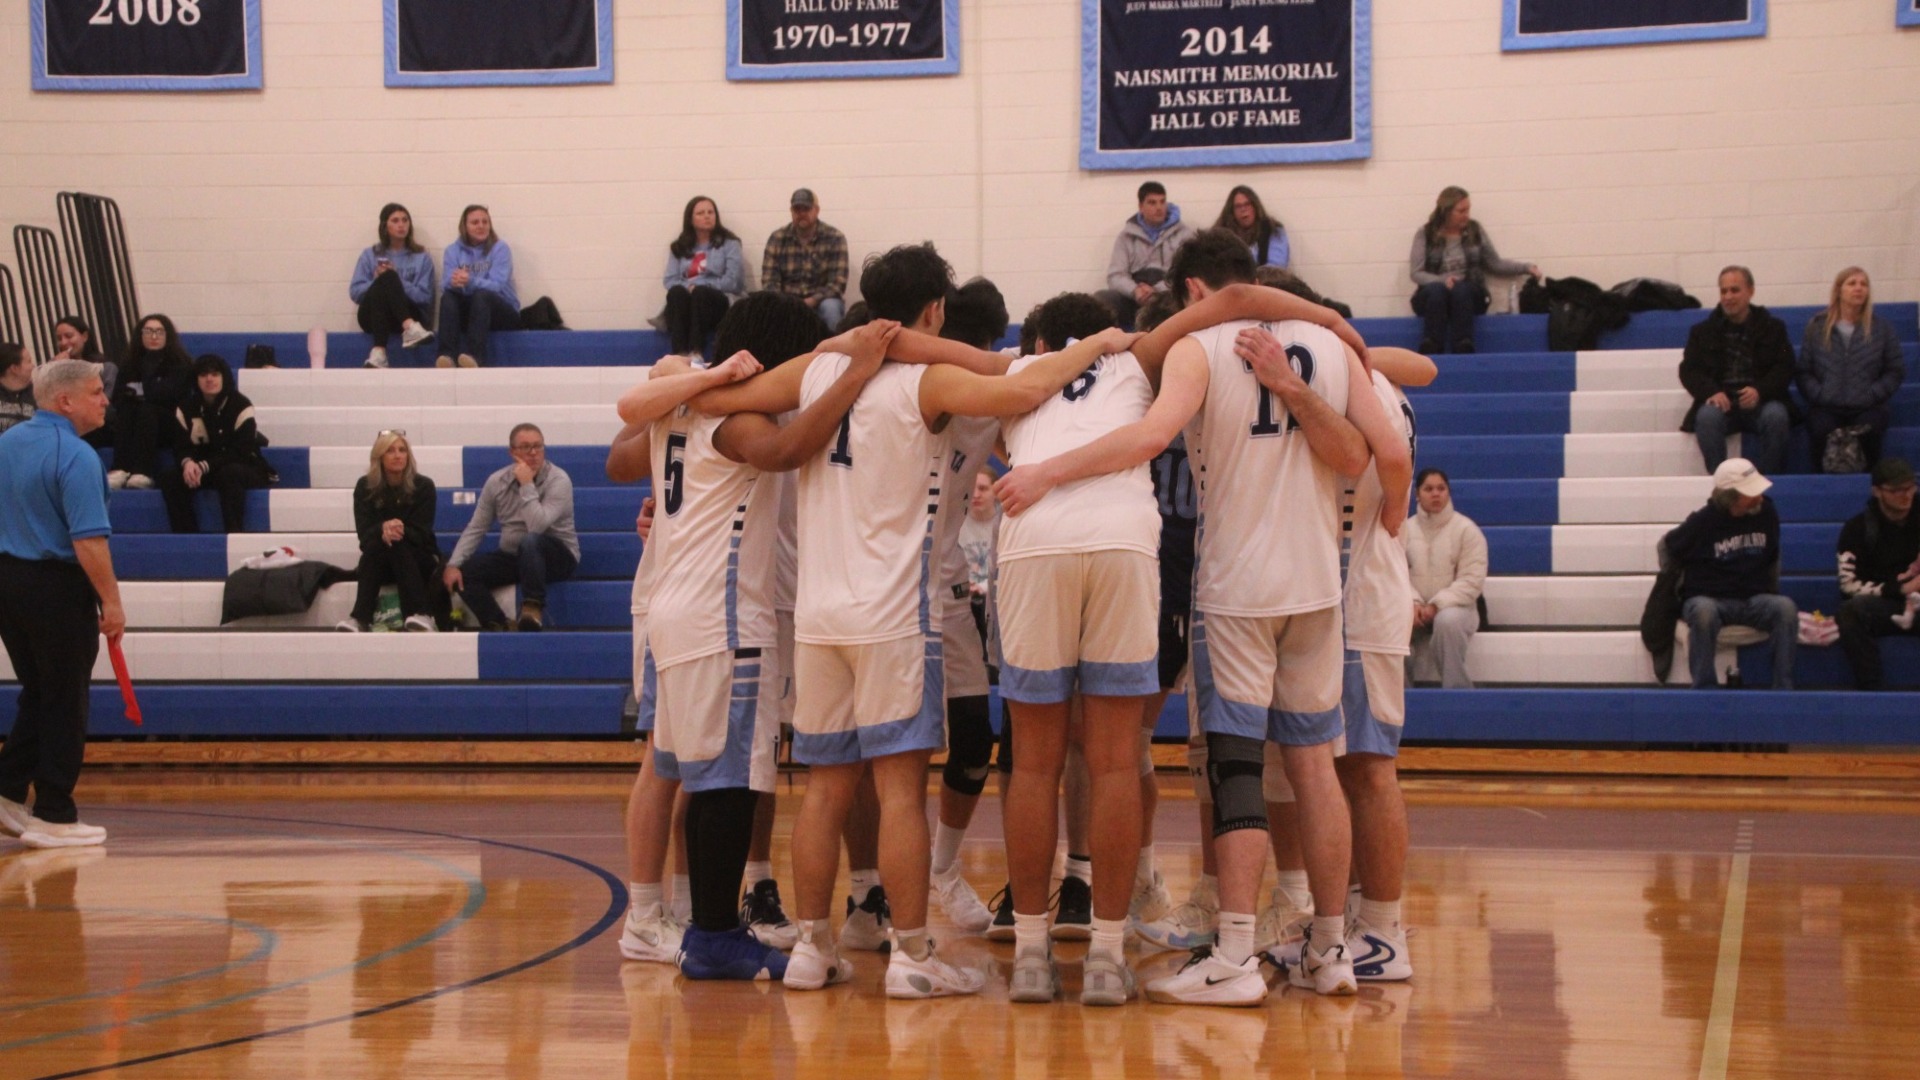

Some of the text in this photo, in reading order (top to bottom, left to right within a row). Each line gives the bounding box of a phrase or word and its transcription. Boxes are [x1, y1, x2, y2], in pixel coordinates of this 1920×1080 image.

[88, 0, 202, 26] 2008
[785, 0, 900, 13] HALL OF FAME
[773, 22, 911, 50] 1970-1977
[1180, 25, 1273, 57] 2014
[1114, 62, 1338, 87] NAISMITH MEMORIAL
[1158, 86, 1292, 108] BASKETBALL
[1150, 109, 1301, 131] HALL OF FAME
[664, 431, 687, 518] 5
